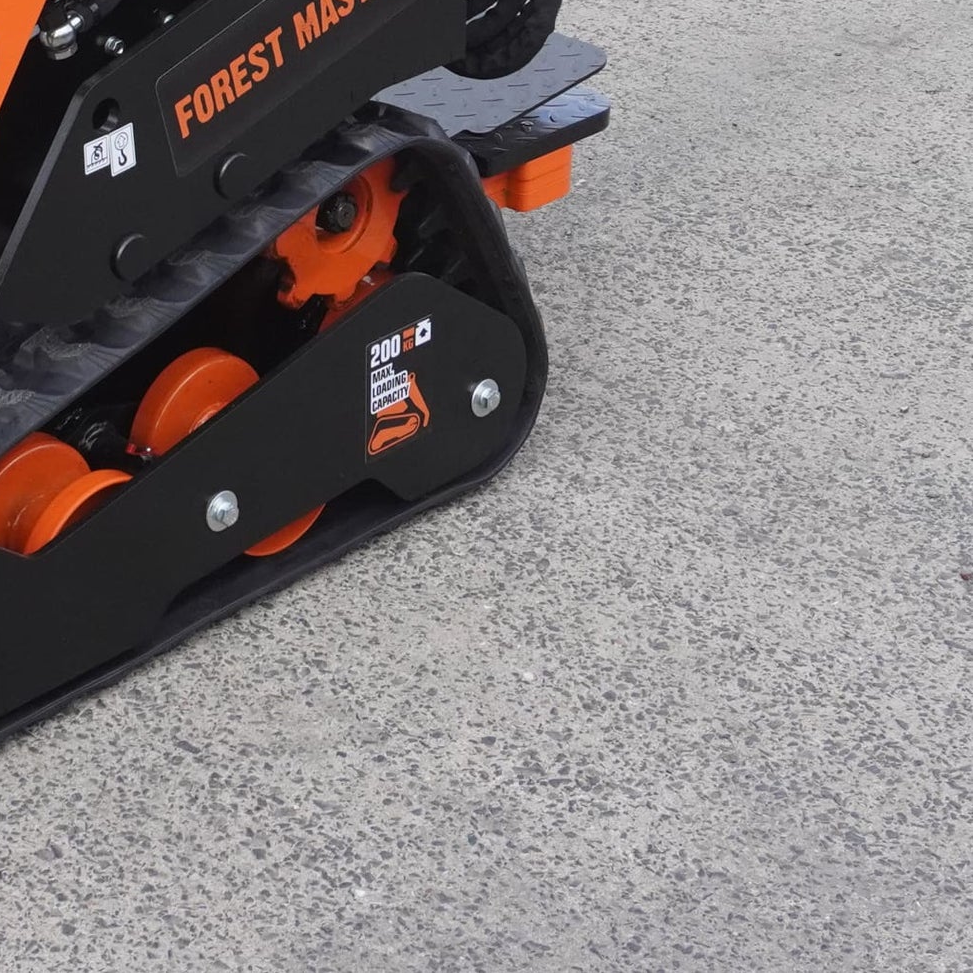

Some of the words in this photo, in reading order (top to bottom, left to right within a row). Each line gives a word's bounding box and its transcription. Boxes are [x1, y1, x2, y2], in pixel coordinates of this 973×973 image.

[174, 26, 284, 139] FOREST
[370, 334, 401, 368] 200
[403, 338, 414, 352] KG
[372, 372, 407, 399] LOADING
[372, 385, 410, 413] CAPACITY
